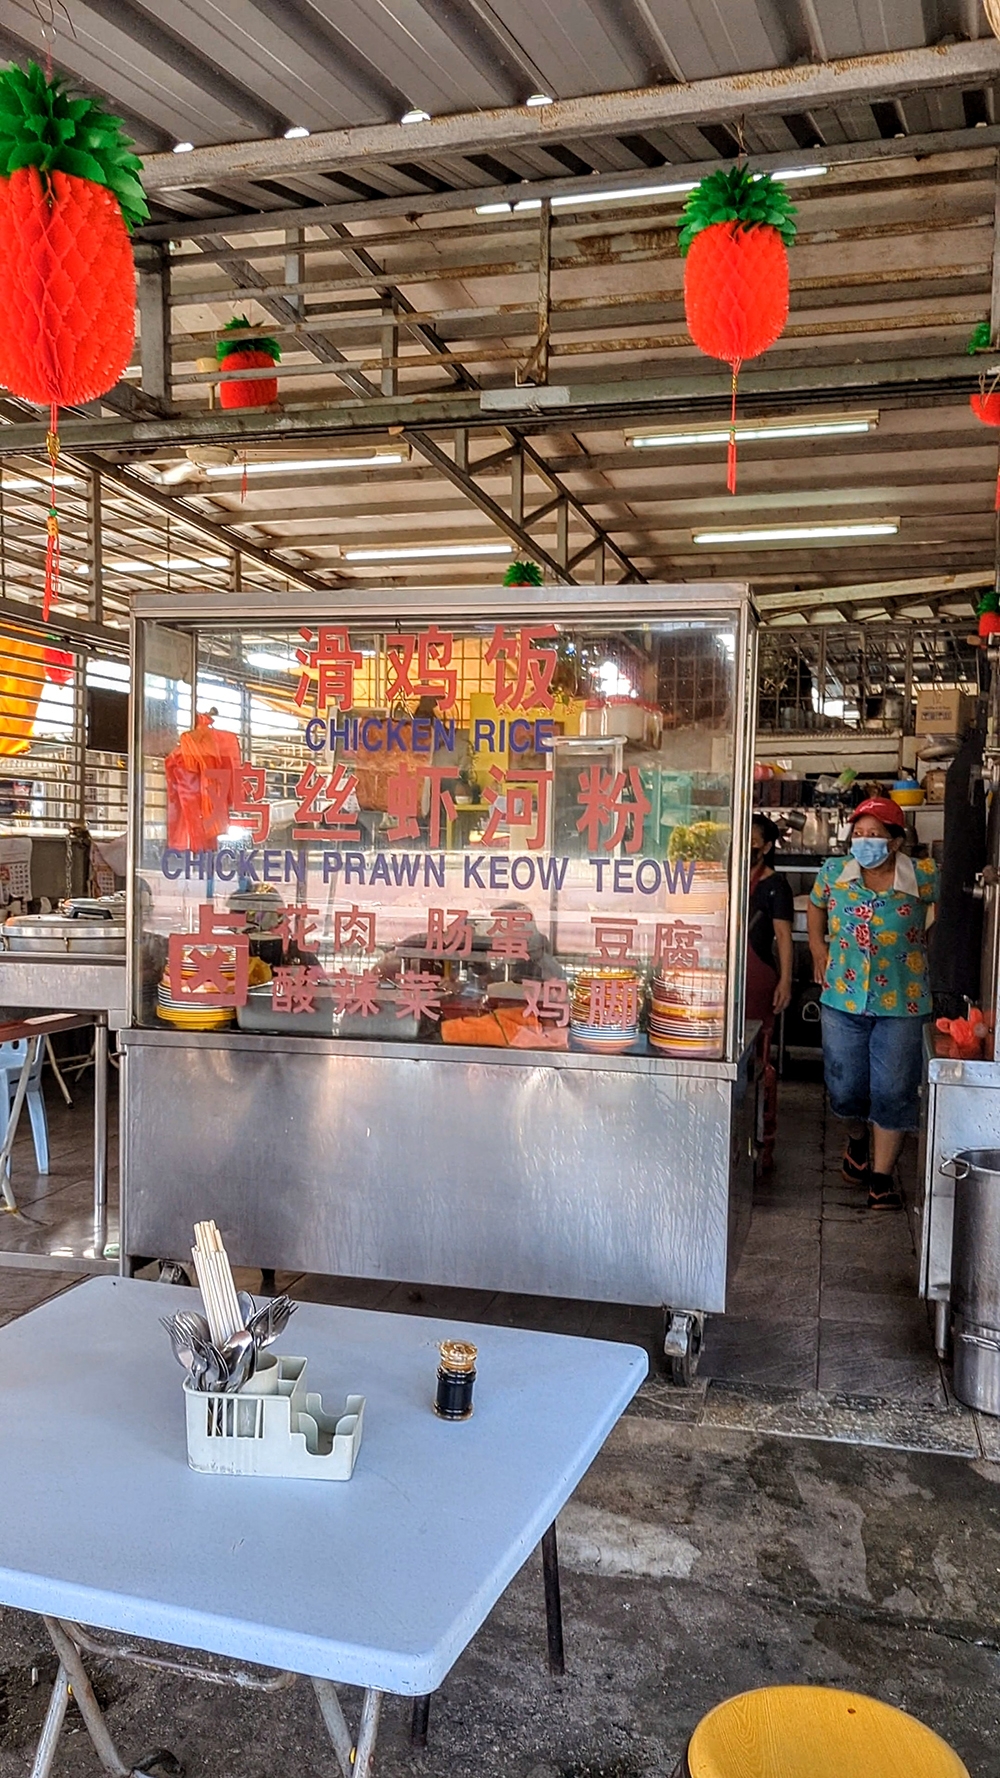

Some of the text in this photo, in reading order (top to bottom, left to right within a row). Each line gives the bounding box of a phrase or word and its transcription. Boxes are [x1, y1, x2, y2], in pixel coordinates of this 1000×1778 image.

[294, 624, 558, 712] 滑鸡饭
[305, 717, 554, 753] CHICKEN RICE
[203, 761, 651, 854] 鸡丝虾河粉
[161, 849, 696, 895] CHICKEN PRAWN KEOW TEOW
[168, 904, 251, 1006] 卤
[273, 903, 703, 970] 花肉 肠蛋 豆腐
[271, 965, 442, 1021] 酸辣菜
